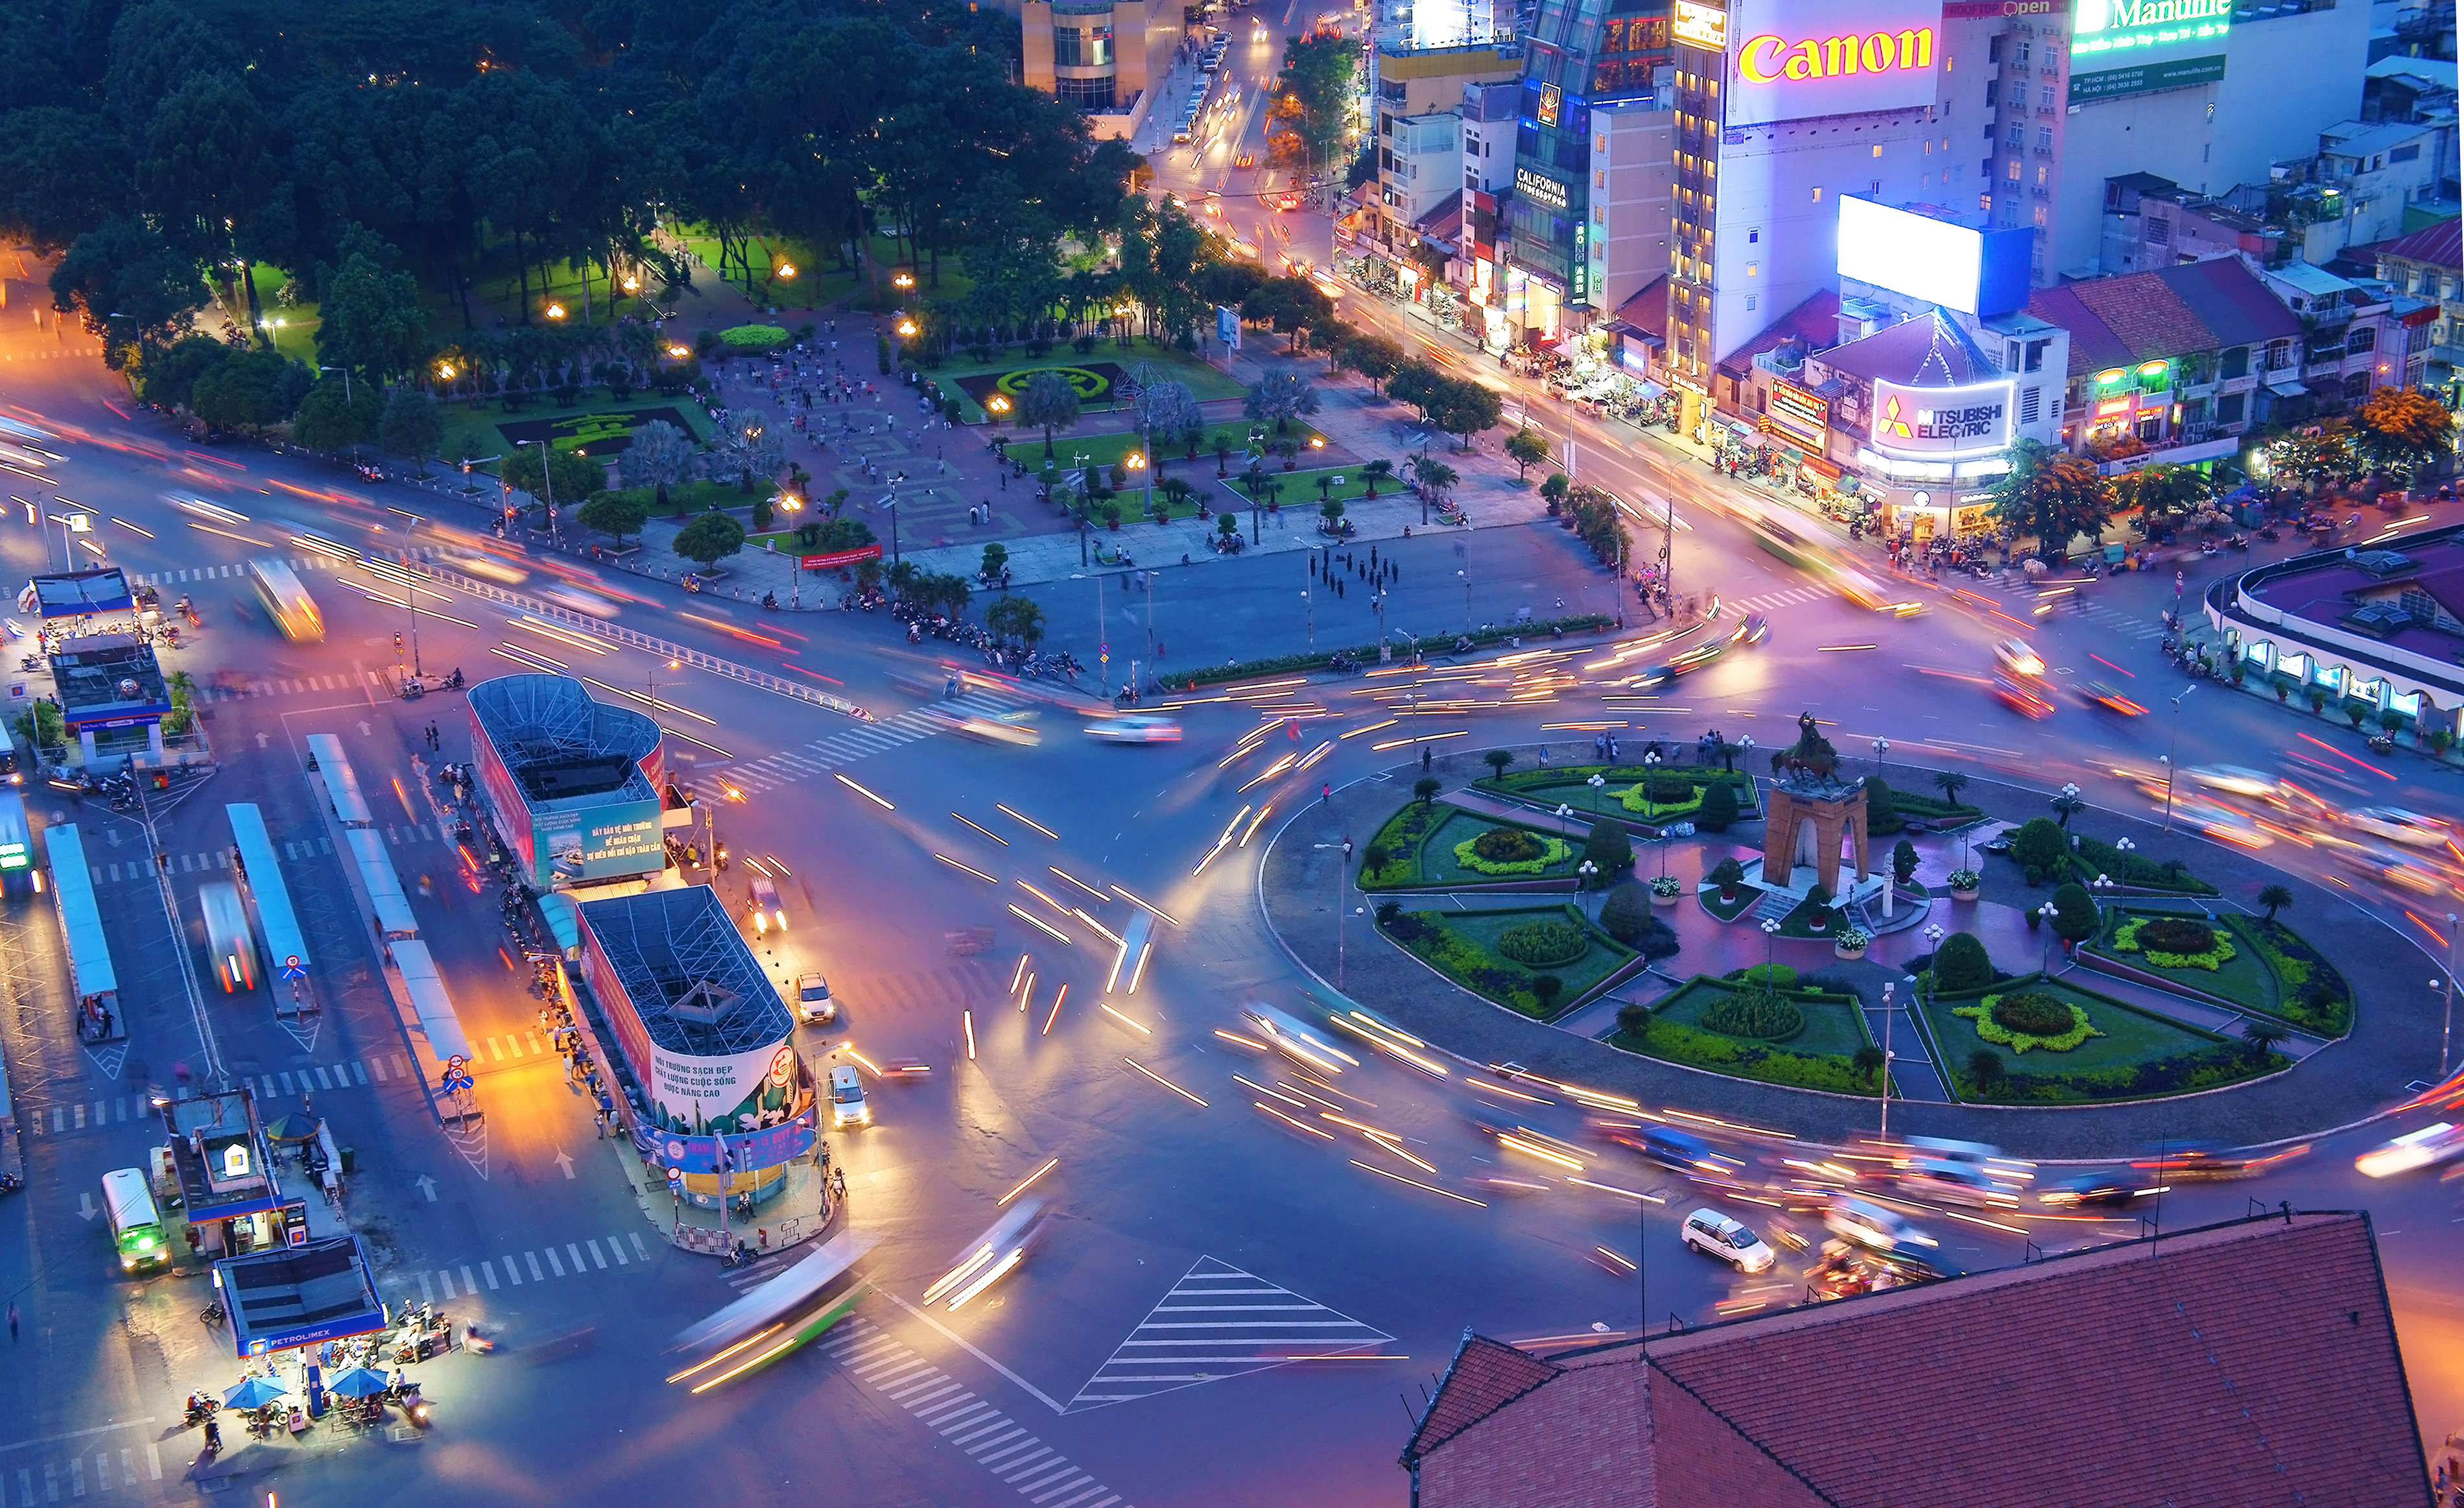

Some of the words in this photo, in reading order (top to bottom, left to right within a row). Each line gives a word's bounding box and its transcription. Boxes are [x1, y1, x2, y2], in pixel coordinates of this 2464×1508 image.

[1950, 4, 1998, 15] ROOFTOP
[1738, 27, 1933, 84] Canon
[2163, 66, 2221, 78] www.manulife.com.vn
[2083, 85, 2091, 93] HÀ
[2092, 84, 2102, 93] NỘI
[1517, 167, 1567, 198] CALIFORNIA
[1574, 224, 1585, 263] SONG
[1574, 265, 1585, 294] ANH
[1917, 404, 2002, 426] MITSUBISHI
[1917, 420, 1991, 439] ELECTRIC
[604, 825, 614, 835] BẢO
[614, 824, 622, 835] VỆ
[622, 823, 632, 833] MÔI
[633, 820, 652, 831] TRƯỜNG
[605, 835, 613, 846] ĐỂ
[636, 843, 650, 854] TOÀN
[655, 1055, 665, 1066] MÔI
[665, 1060, 691, 1073] TRƯỜNG
[693, 1066, 713, 1076] SẠCH
[717, 1066, 733, 1077] ĐẸP
[655, 1066, 666, 1078] CHẤT
[667, 1073, 689, 1084] LƯỢNG
[691, 1077, 711, 1088] CUỘC
[714, 1076, 736, 1086] SỐNG
[664, 1083, 679, 1094] ĐƯỢC
[681, 1088, 702, 1097] NÂNG
[687, 1142, 711, 1156] TRẠM
[760, 1135, 770, 1147] XE
[772, 1127, 790, 1144] BUÝT
[271, 1329, 330, 1346] PETROLIMEX
